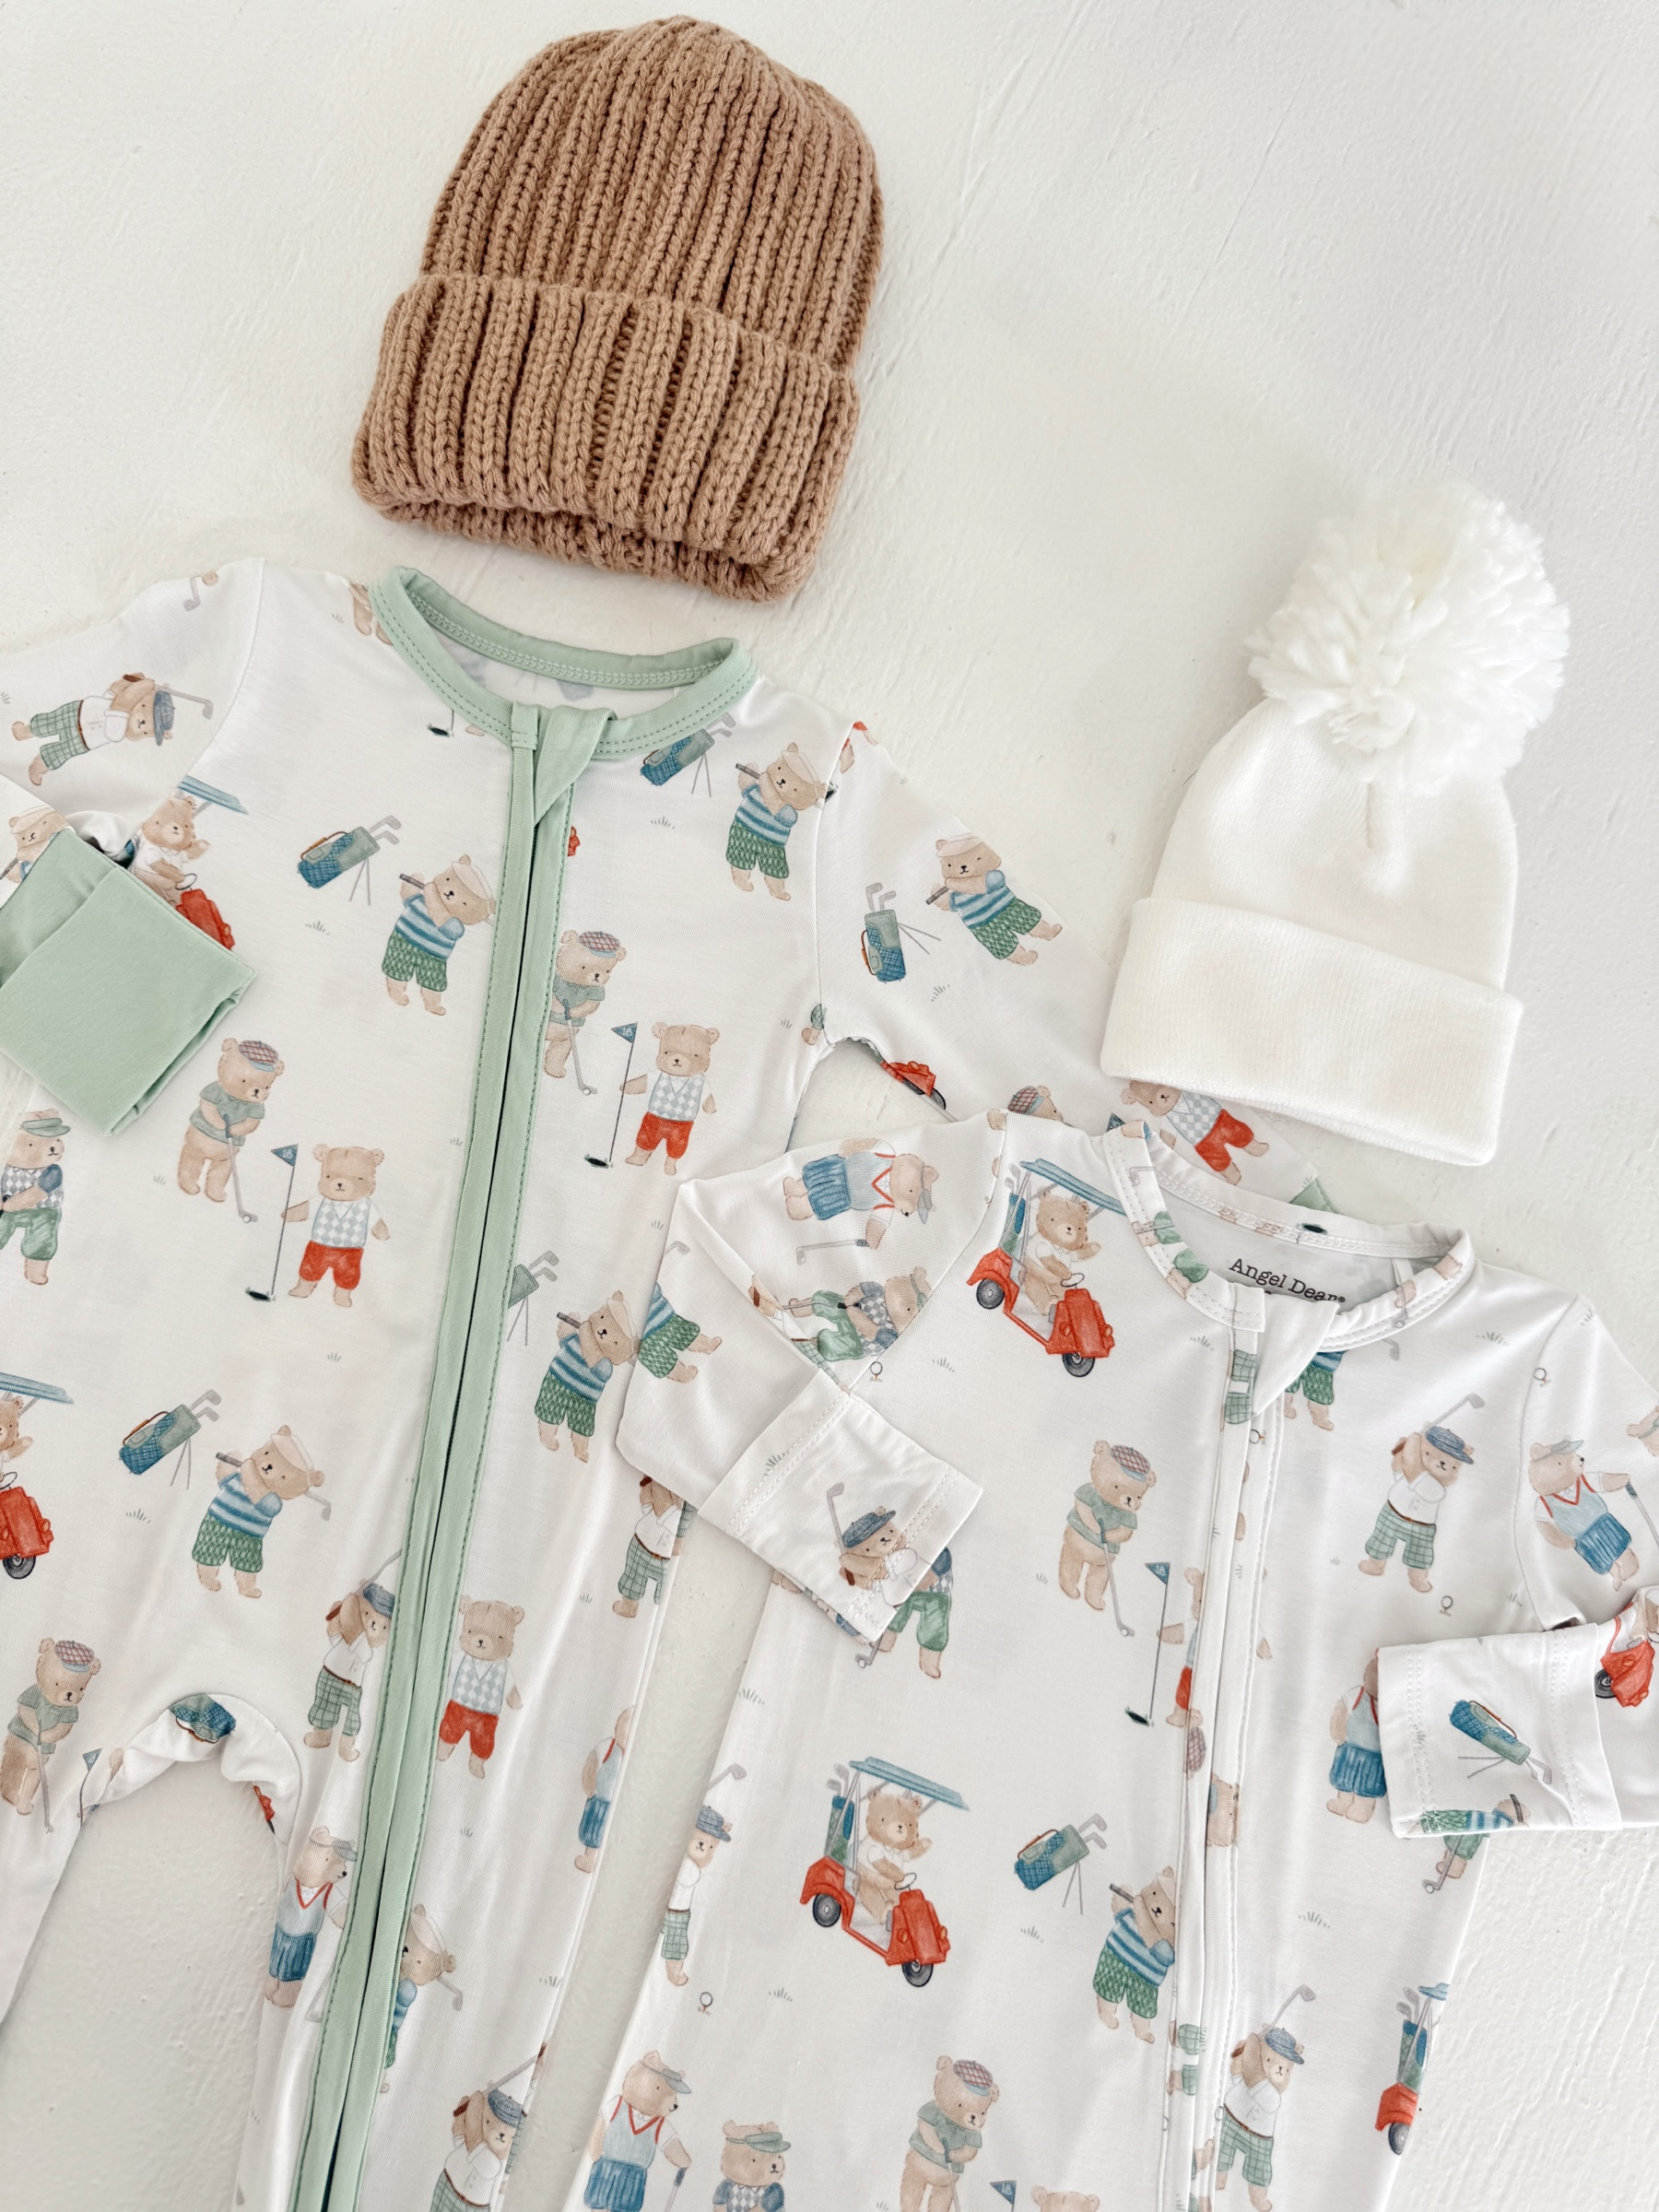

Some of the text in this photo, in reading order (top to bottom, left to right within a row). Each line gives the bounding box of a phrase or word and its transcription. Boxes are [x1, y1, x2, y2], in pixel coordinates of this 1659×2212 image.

[622, 1027, 632, 1036] 18
[283, 1148, 293, 1159] 18
[1229, 1258, 1288, 1286] Angel
[1156, 1564, 1166, 1576] 18
[1002, 2183, 1012, 2194] 18
